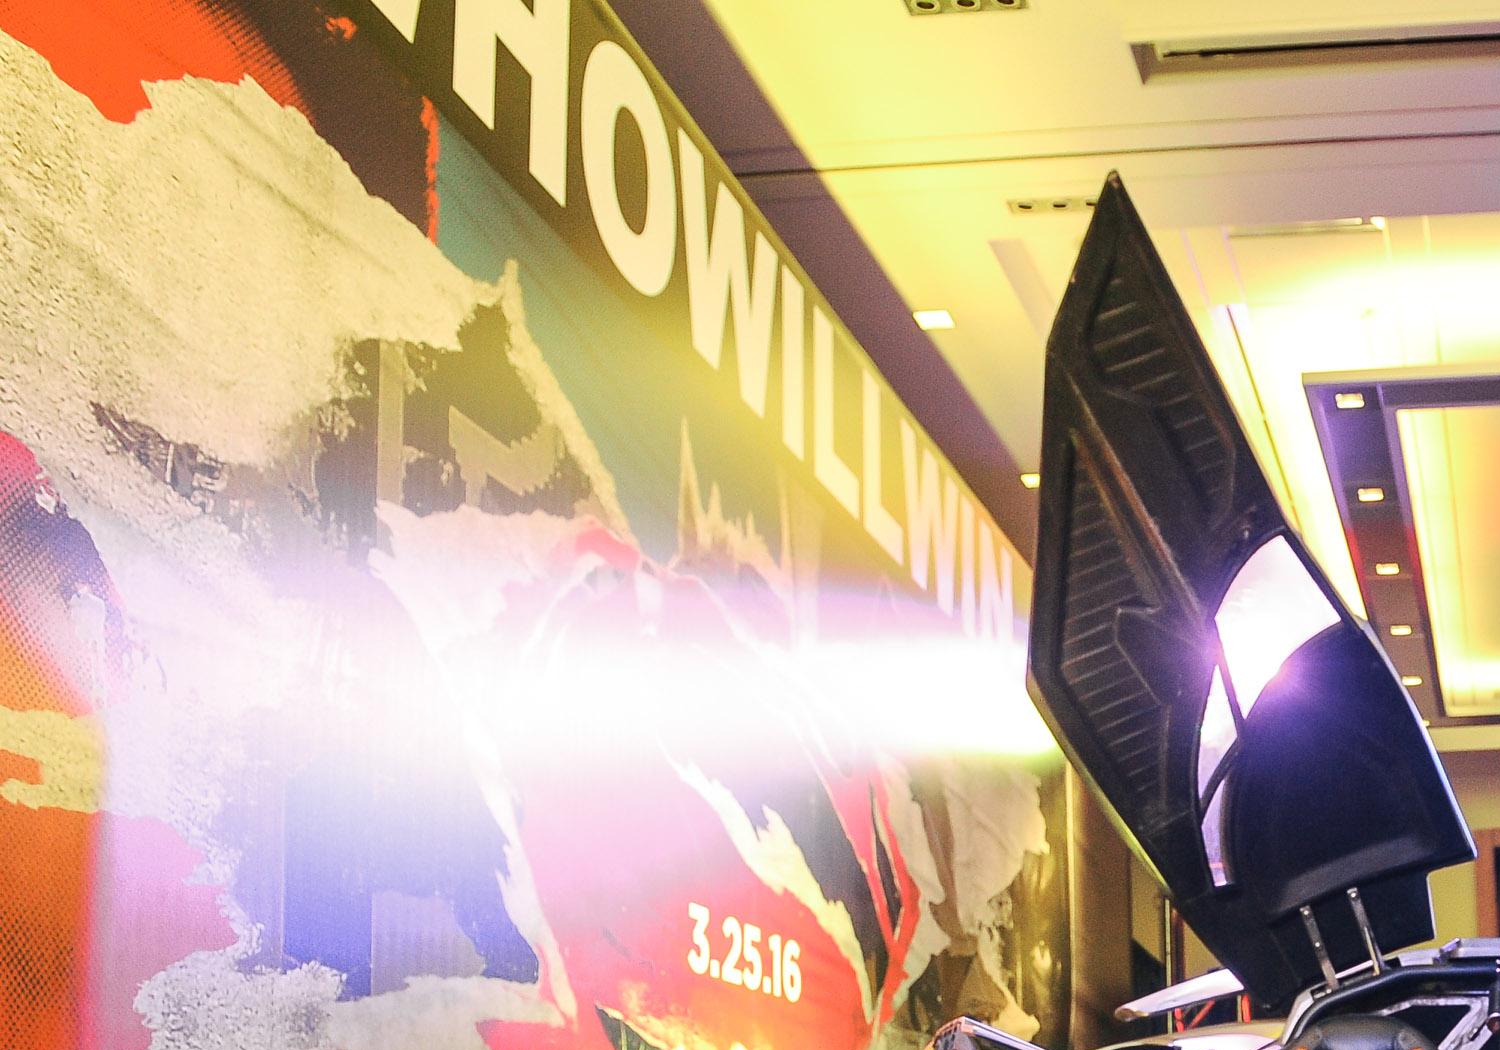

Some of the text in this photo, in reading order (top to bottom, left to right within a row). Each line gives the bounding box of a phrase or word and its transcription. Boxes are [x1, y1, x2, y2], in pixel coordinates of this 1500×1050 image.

[677, 128, 904, 567] WILL
[900, 418, 1014, 641] WIN
[687, 901, 802, 1004] 3.25.16
